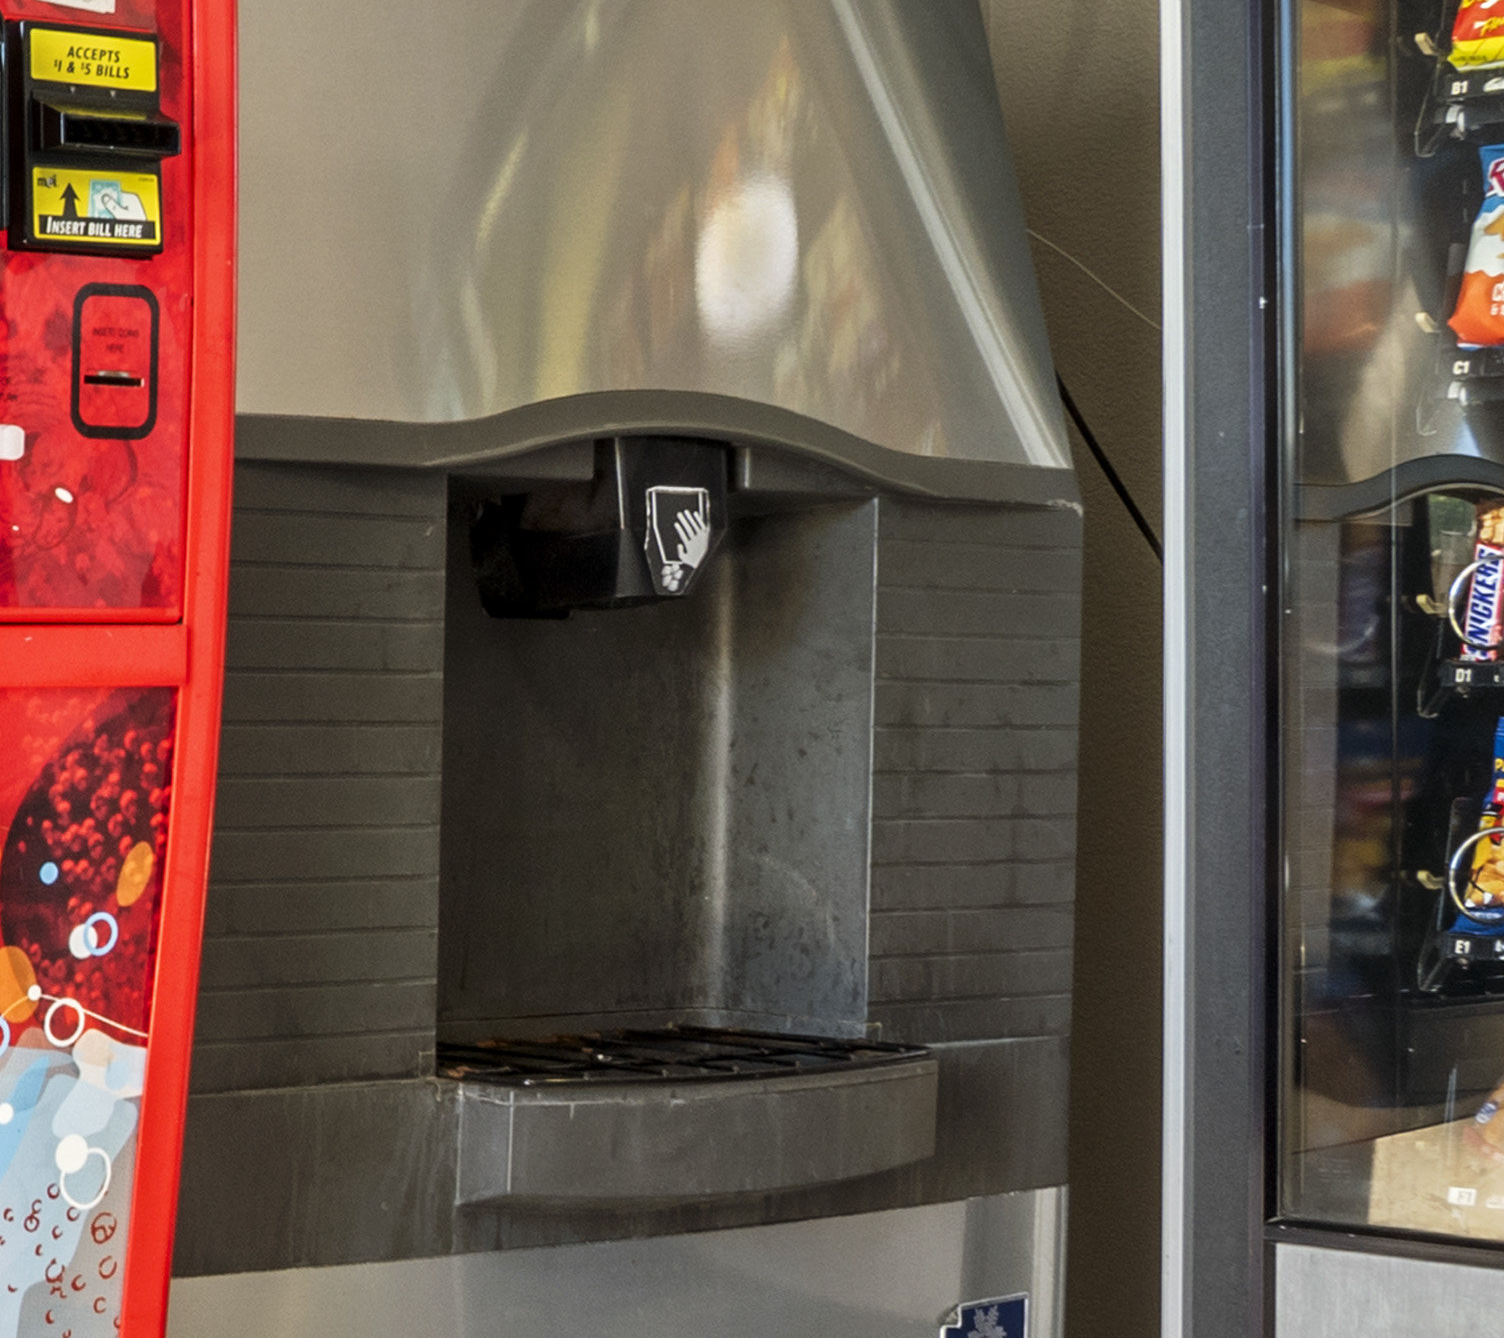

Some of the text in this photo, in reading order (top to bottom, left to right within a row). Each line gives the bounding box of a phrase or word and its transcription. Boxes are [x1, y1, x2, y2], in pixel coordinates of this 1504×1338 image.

[66, 45, 122, 64] ACCEPTS
[65, 60, 77, 73] &
[95, 63, 131, 80] BILLS
[45, 218, 143, 239] INSERT BILL HERE
